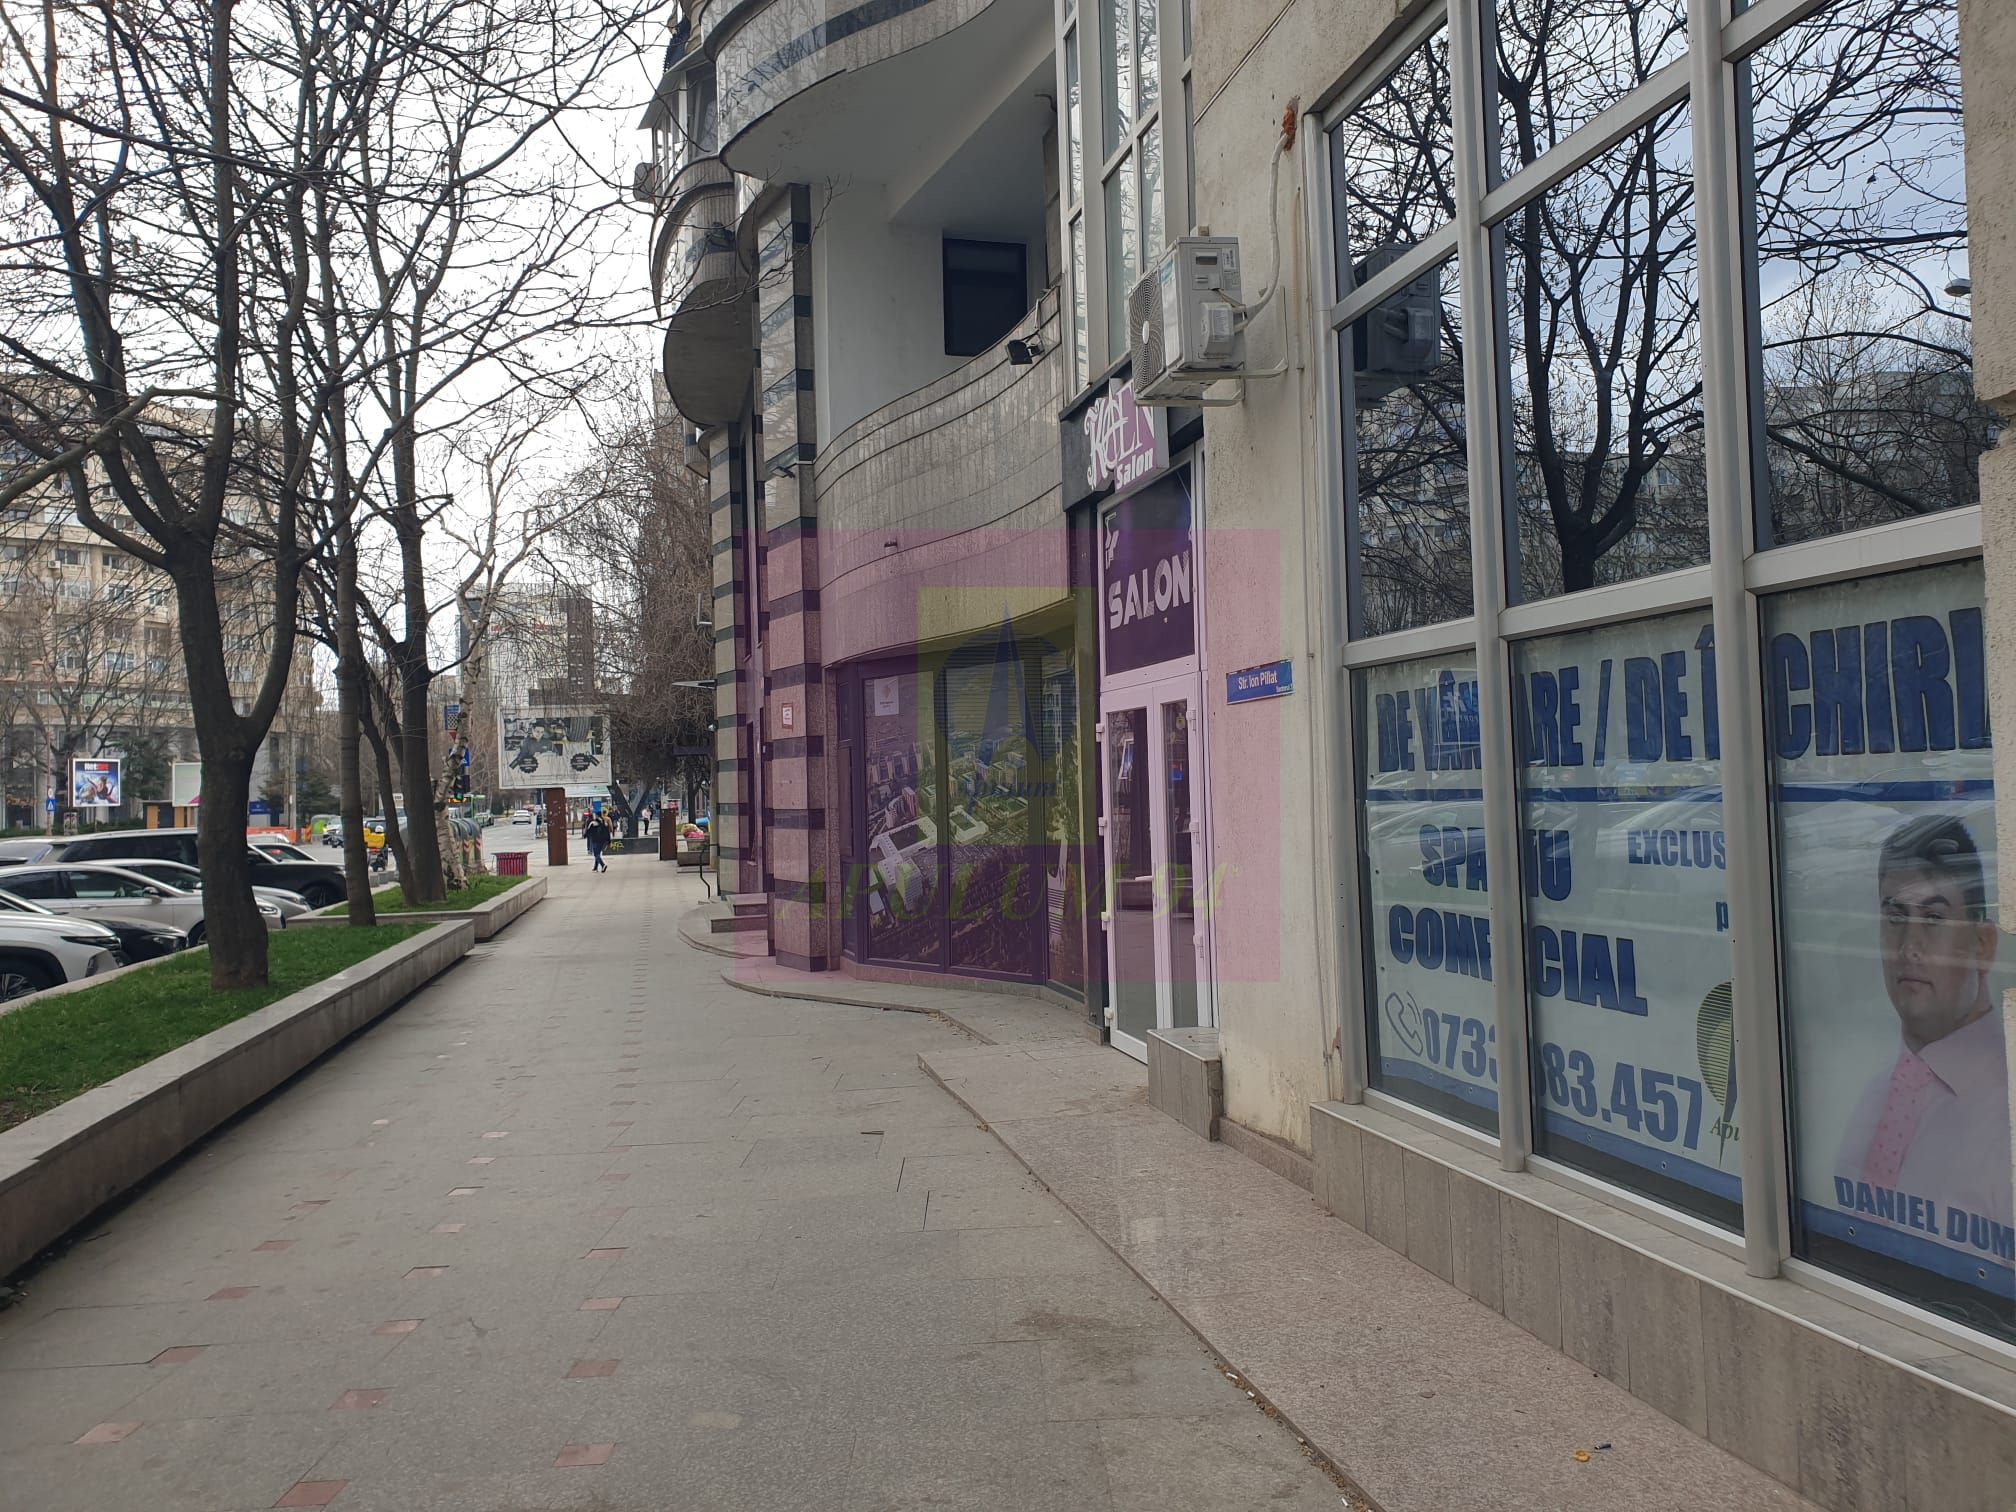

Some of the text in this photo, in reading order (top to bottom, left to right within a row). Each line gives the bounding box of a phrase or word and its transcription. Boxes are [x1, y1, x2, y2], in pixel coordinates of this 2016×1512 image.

[1115, 448, 1154, 490] salon
[1108, 550, 1191, 631] SALON
[1238, 676, 1249, 690] Str.
[1249, 674, 1260, 689] Ion
[1260, 670, 1278, 687] Pillat
[1375, 690, 1415, 773] DE
[1624, 651, 1693, 764] DE
[1694, 606, 1993, 761] ÎCHIRI
[1420, 823, 1572, 901] SPAIU
[1627, 829, 1726, 870] EXCLUS
[1388, 903, 1649, 1018] COMECIAL
[1422, 1007, 1703, 1151] 07383.457
[1833, 1175, 2016, 1261] DANIEL DUM
